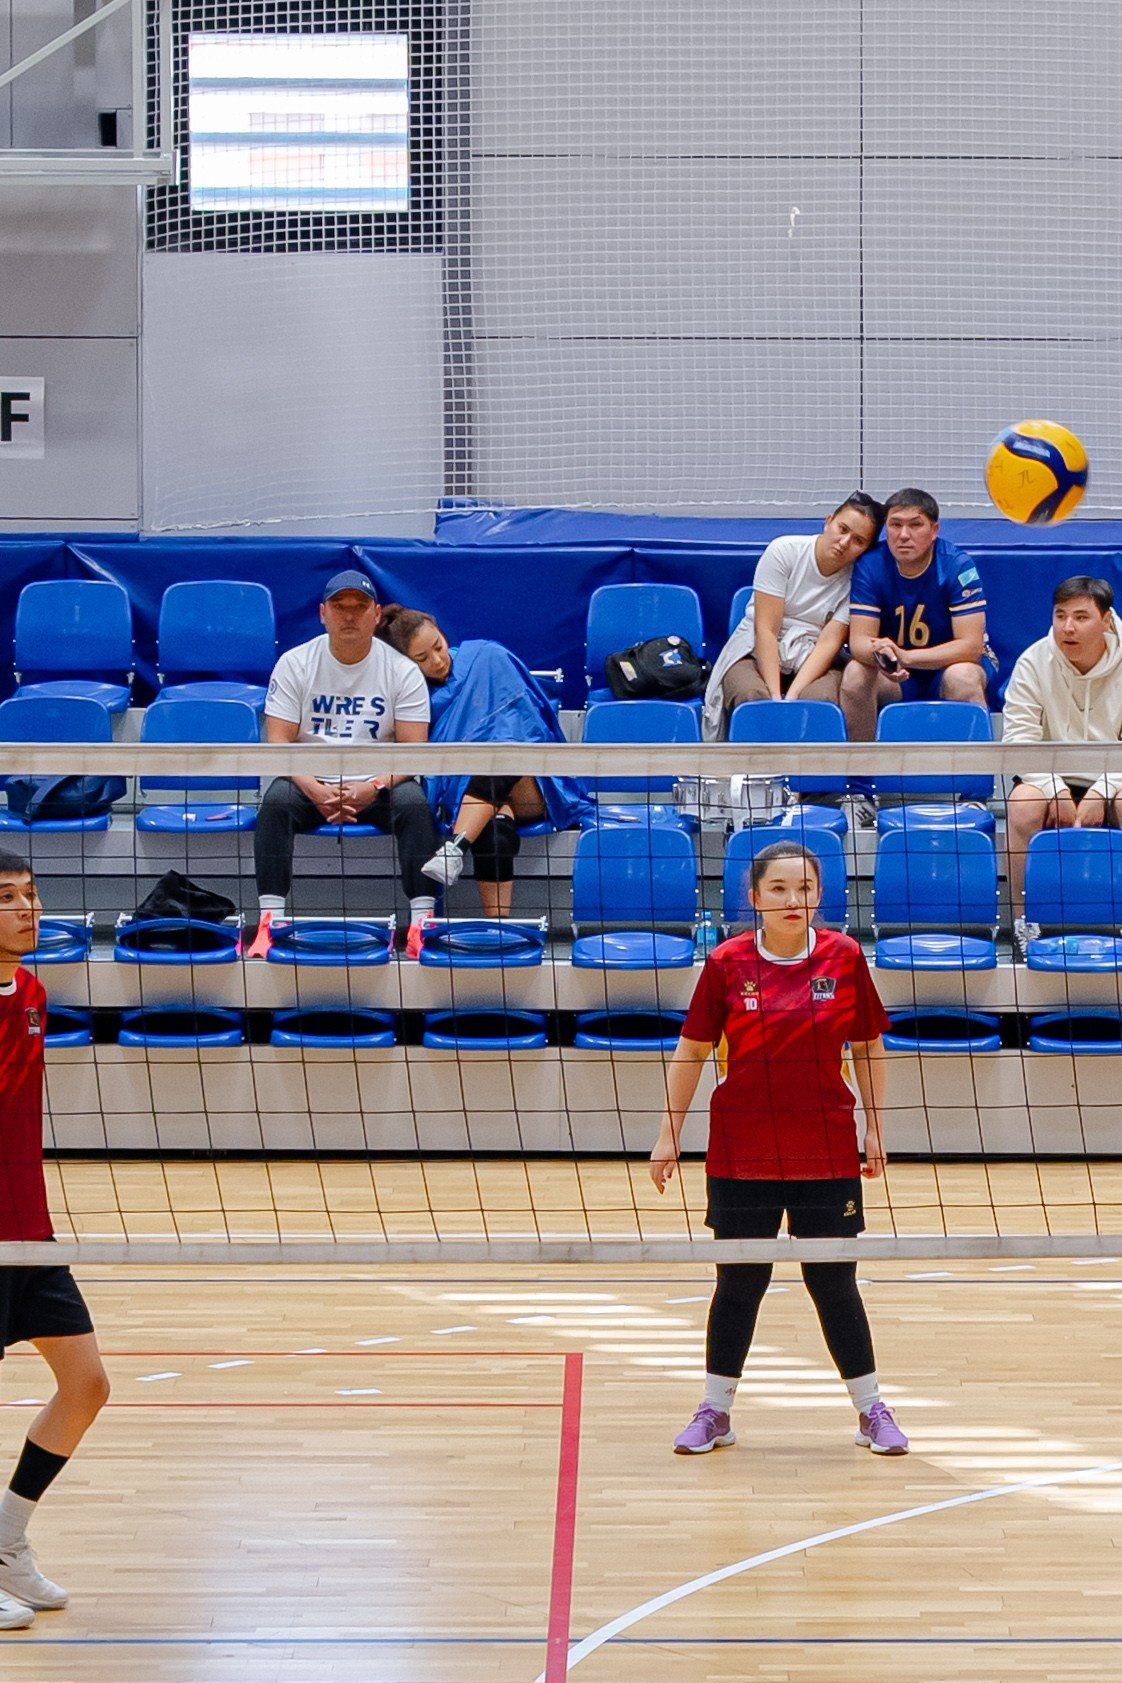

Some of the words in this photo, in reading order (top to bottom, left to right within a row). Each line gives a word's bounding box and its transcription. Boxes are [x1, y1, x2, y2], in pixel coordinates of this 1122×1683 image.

[1, 392, 30, 441] F
[895, 604, 930, 646] 16
[744, 998, 758, 1010] 10
